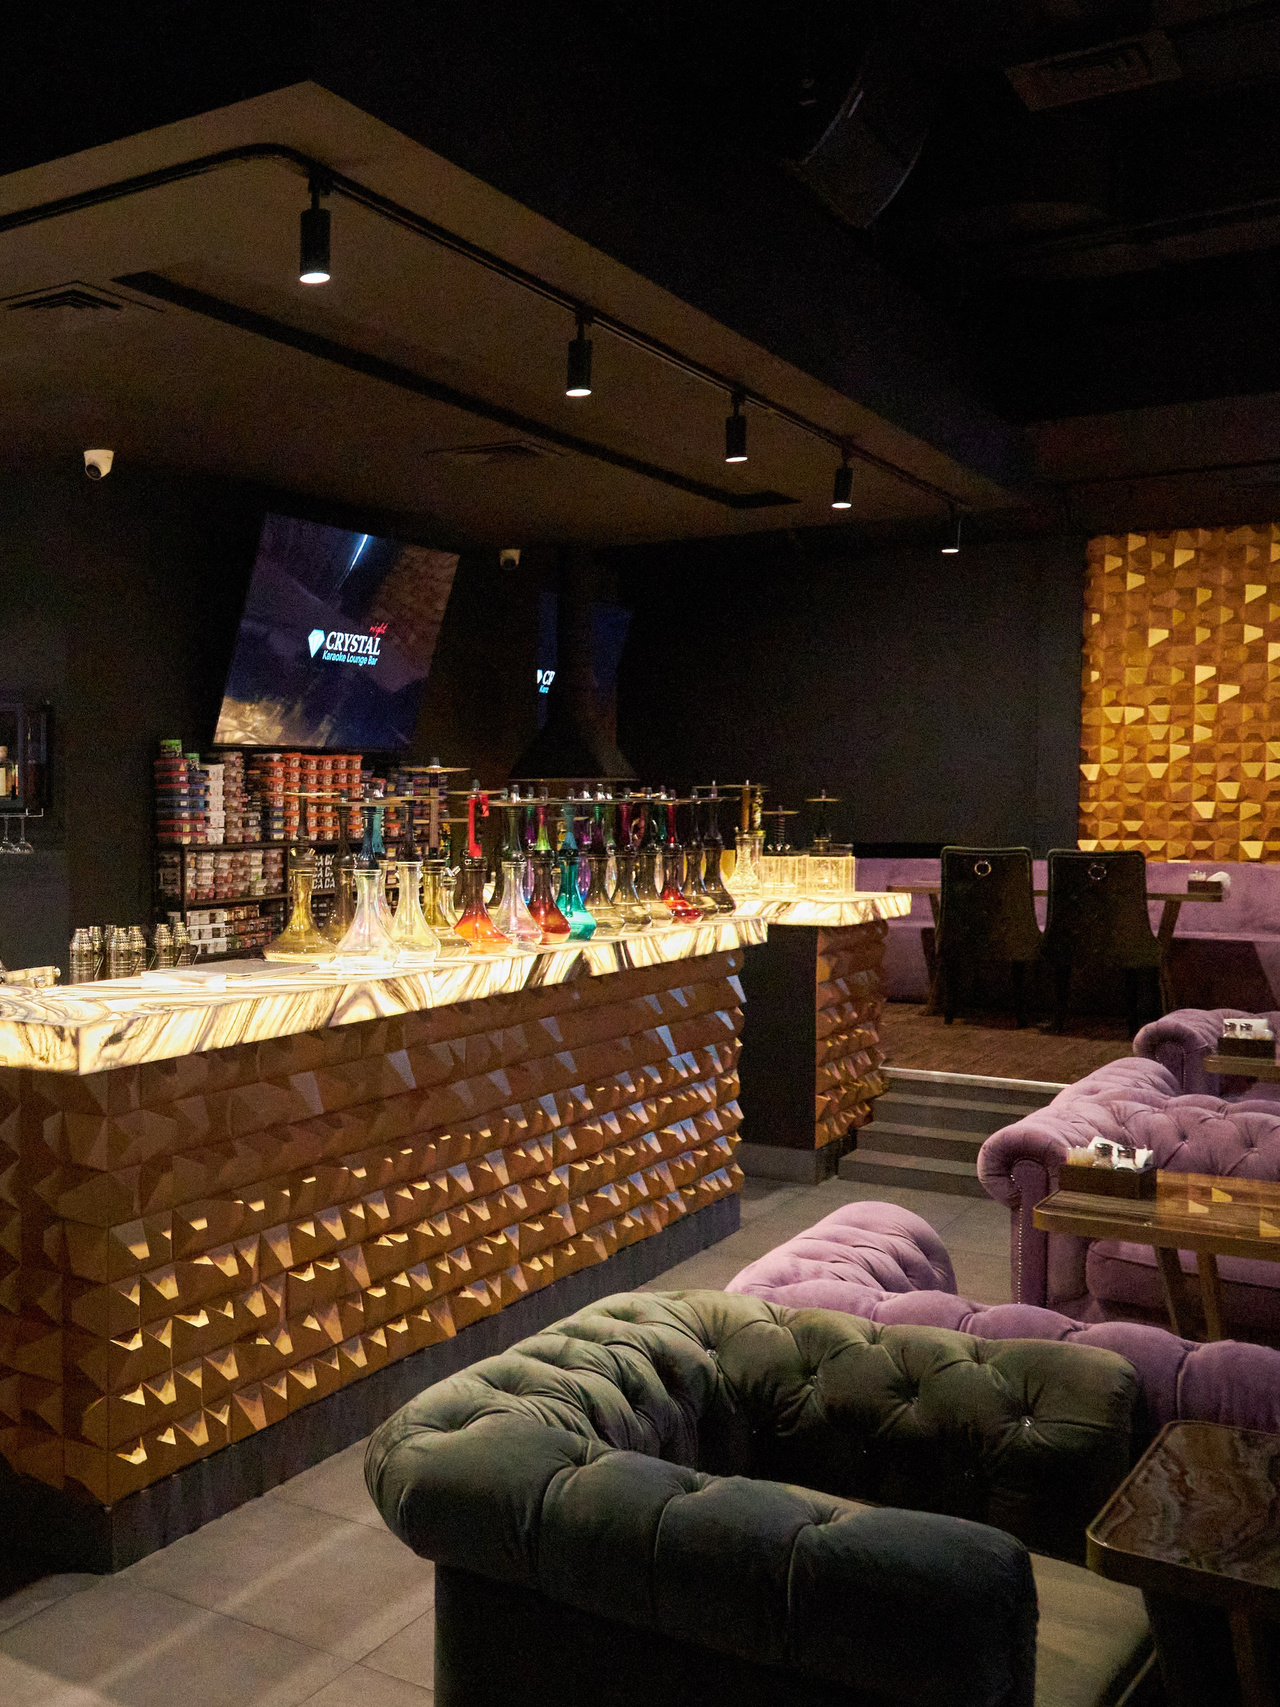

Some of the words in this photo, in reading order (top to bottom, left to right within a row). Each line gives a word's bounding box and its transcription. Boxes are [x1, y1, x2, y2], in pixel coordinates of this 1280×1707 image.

[326, 631, 381, 655] CRYSTAL
[322, 650, 346, 662] Karaoke
[346, 652, 368, 666] Lounge
[368, 655, 379, 666] Bar
